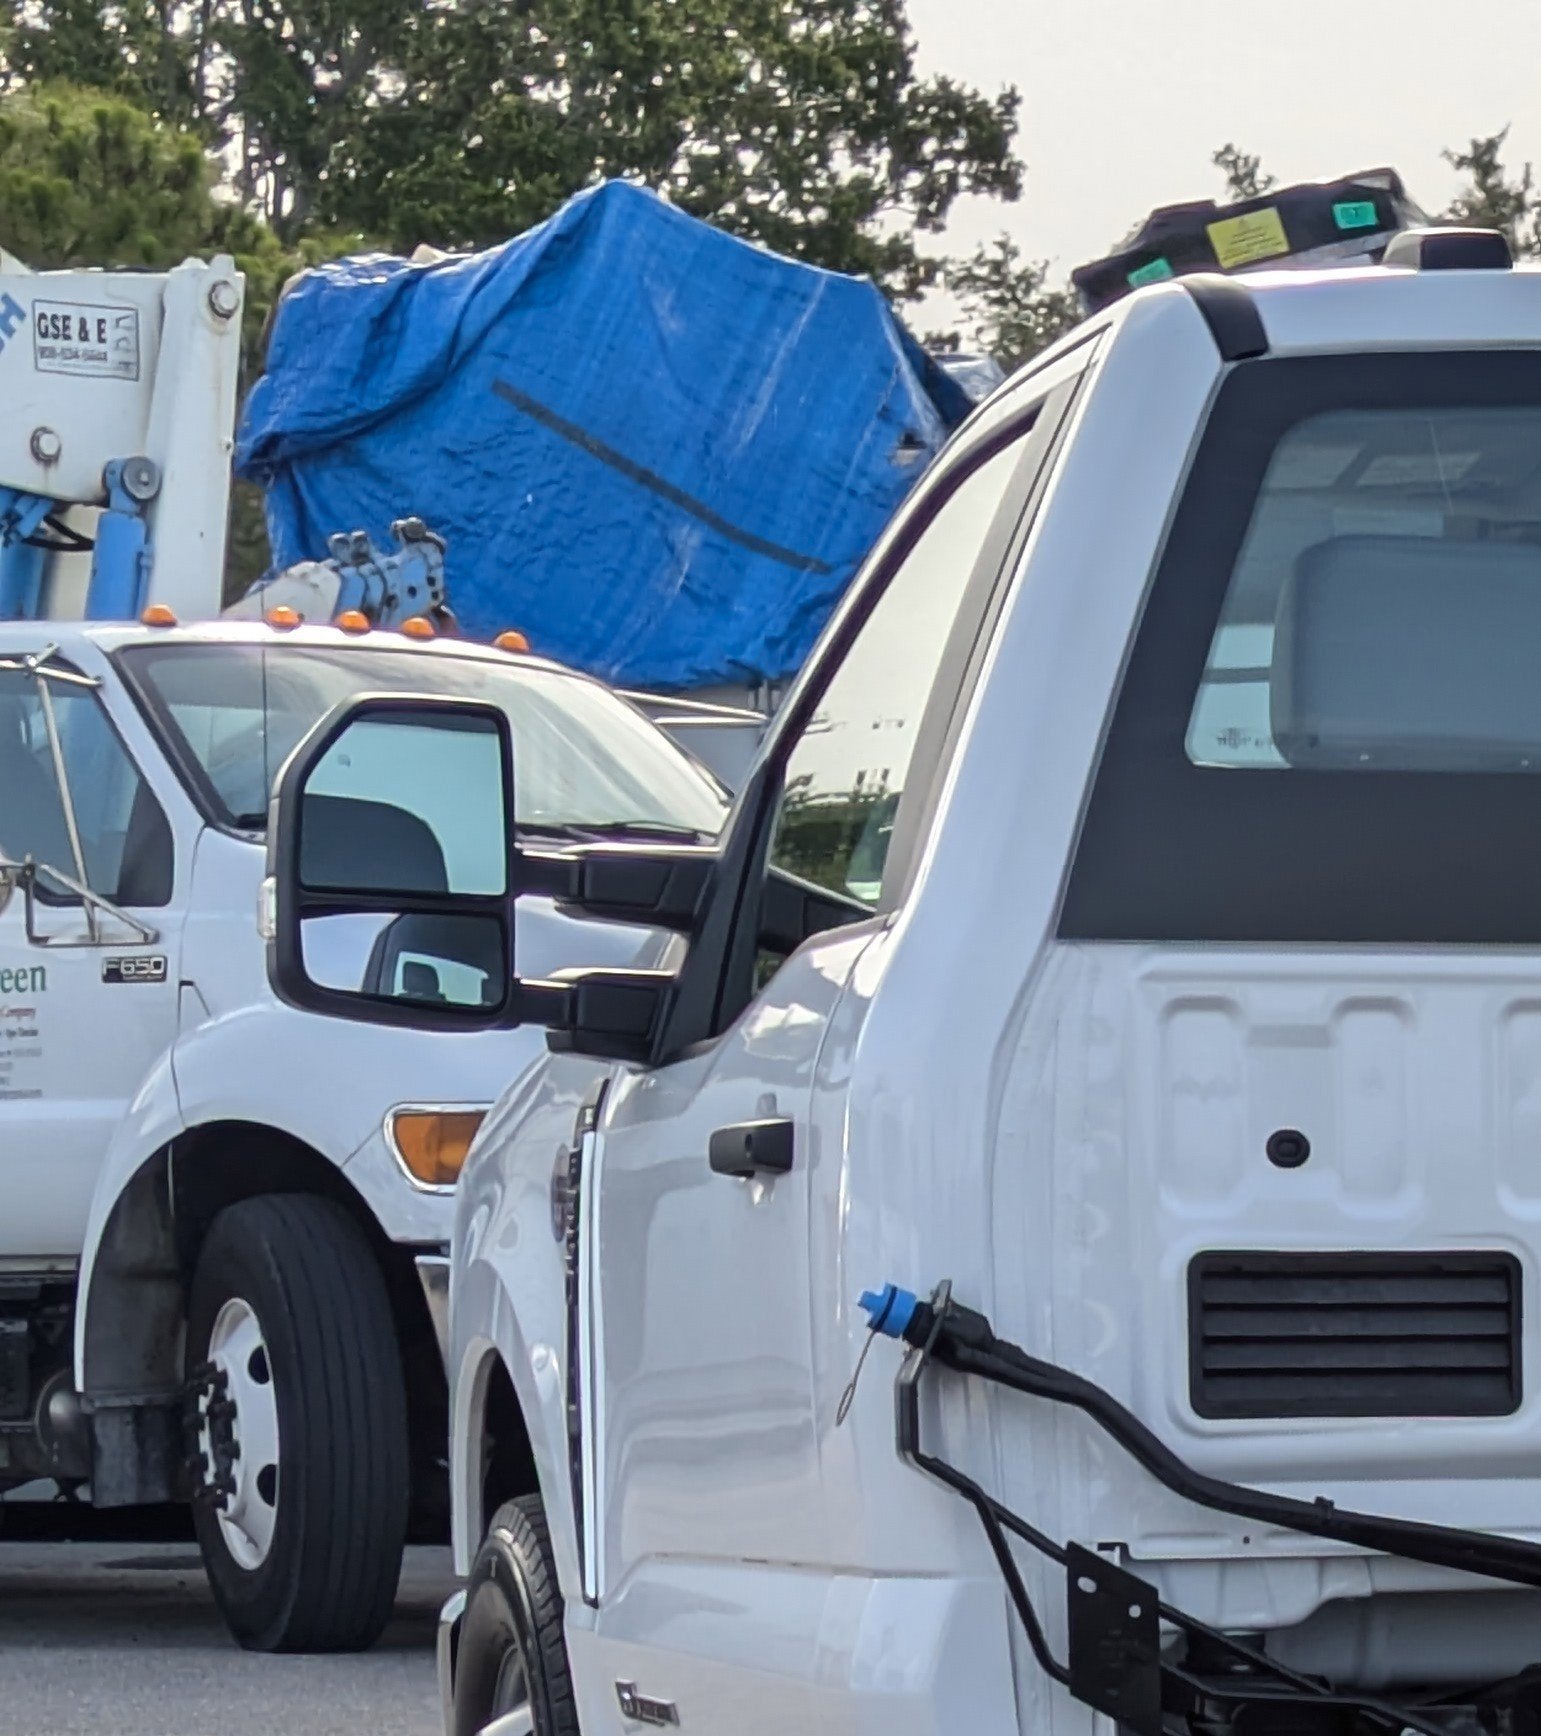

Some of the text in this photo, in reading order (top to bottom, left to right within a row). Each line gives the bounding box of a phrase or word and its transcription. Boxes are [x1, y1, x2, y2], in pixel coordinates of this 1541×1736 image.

[37, 312, 71, 340] GSE
[78, 316, 90, 341] &
[96, 318, 107, 343] E
[0, 965, 46, 993] een
[102, 957, 164, 975] F650
